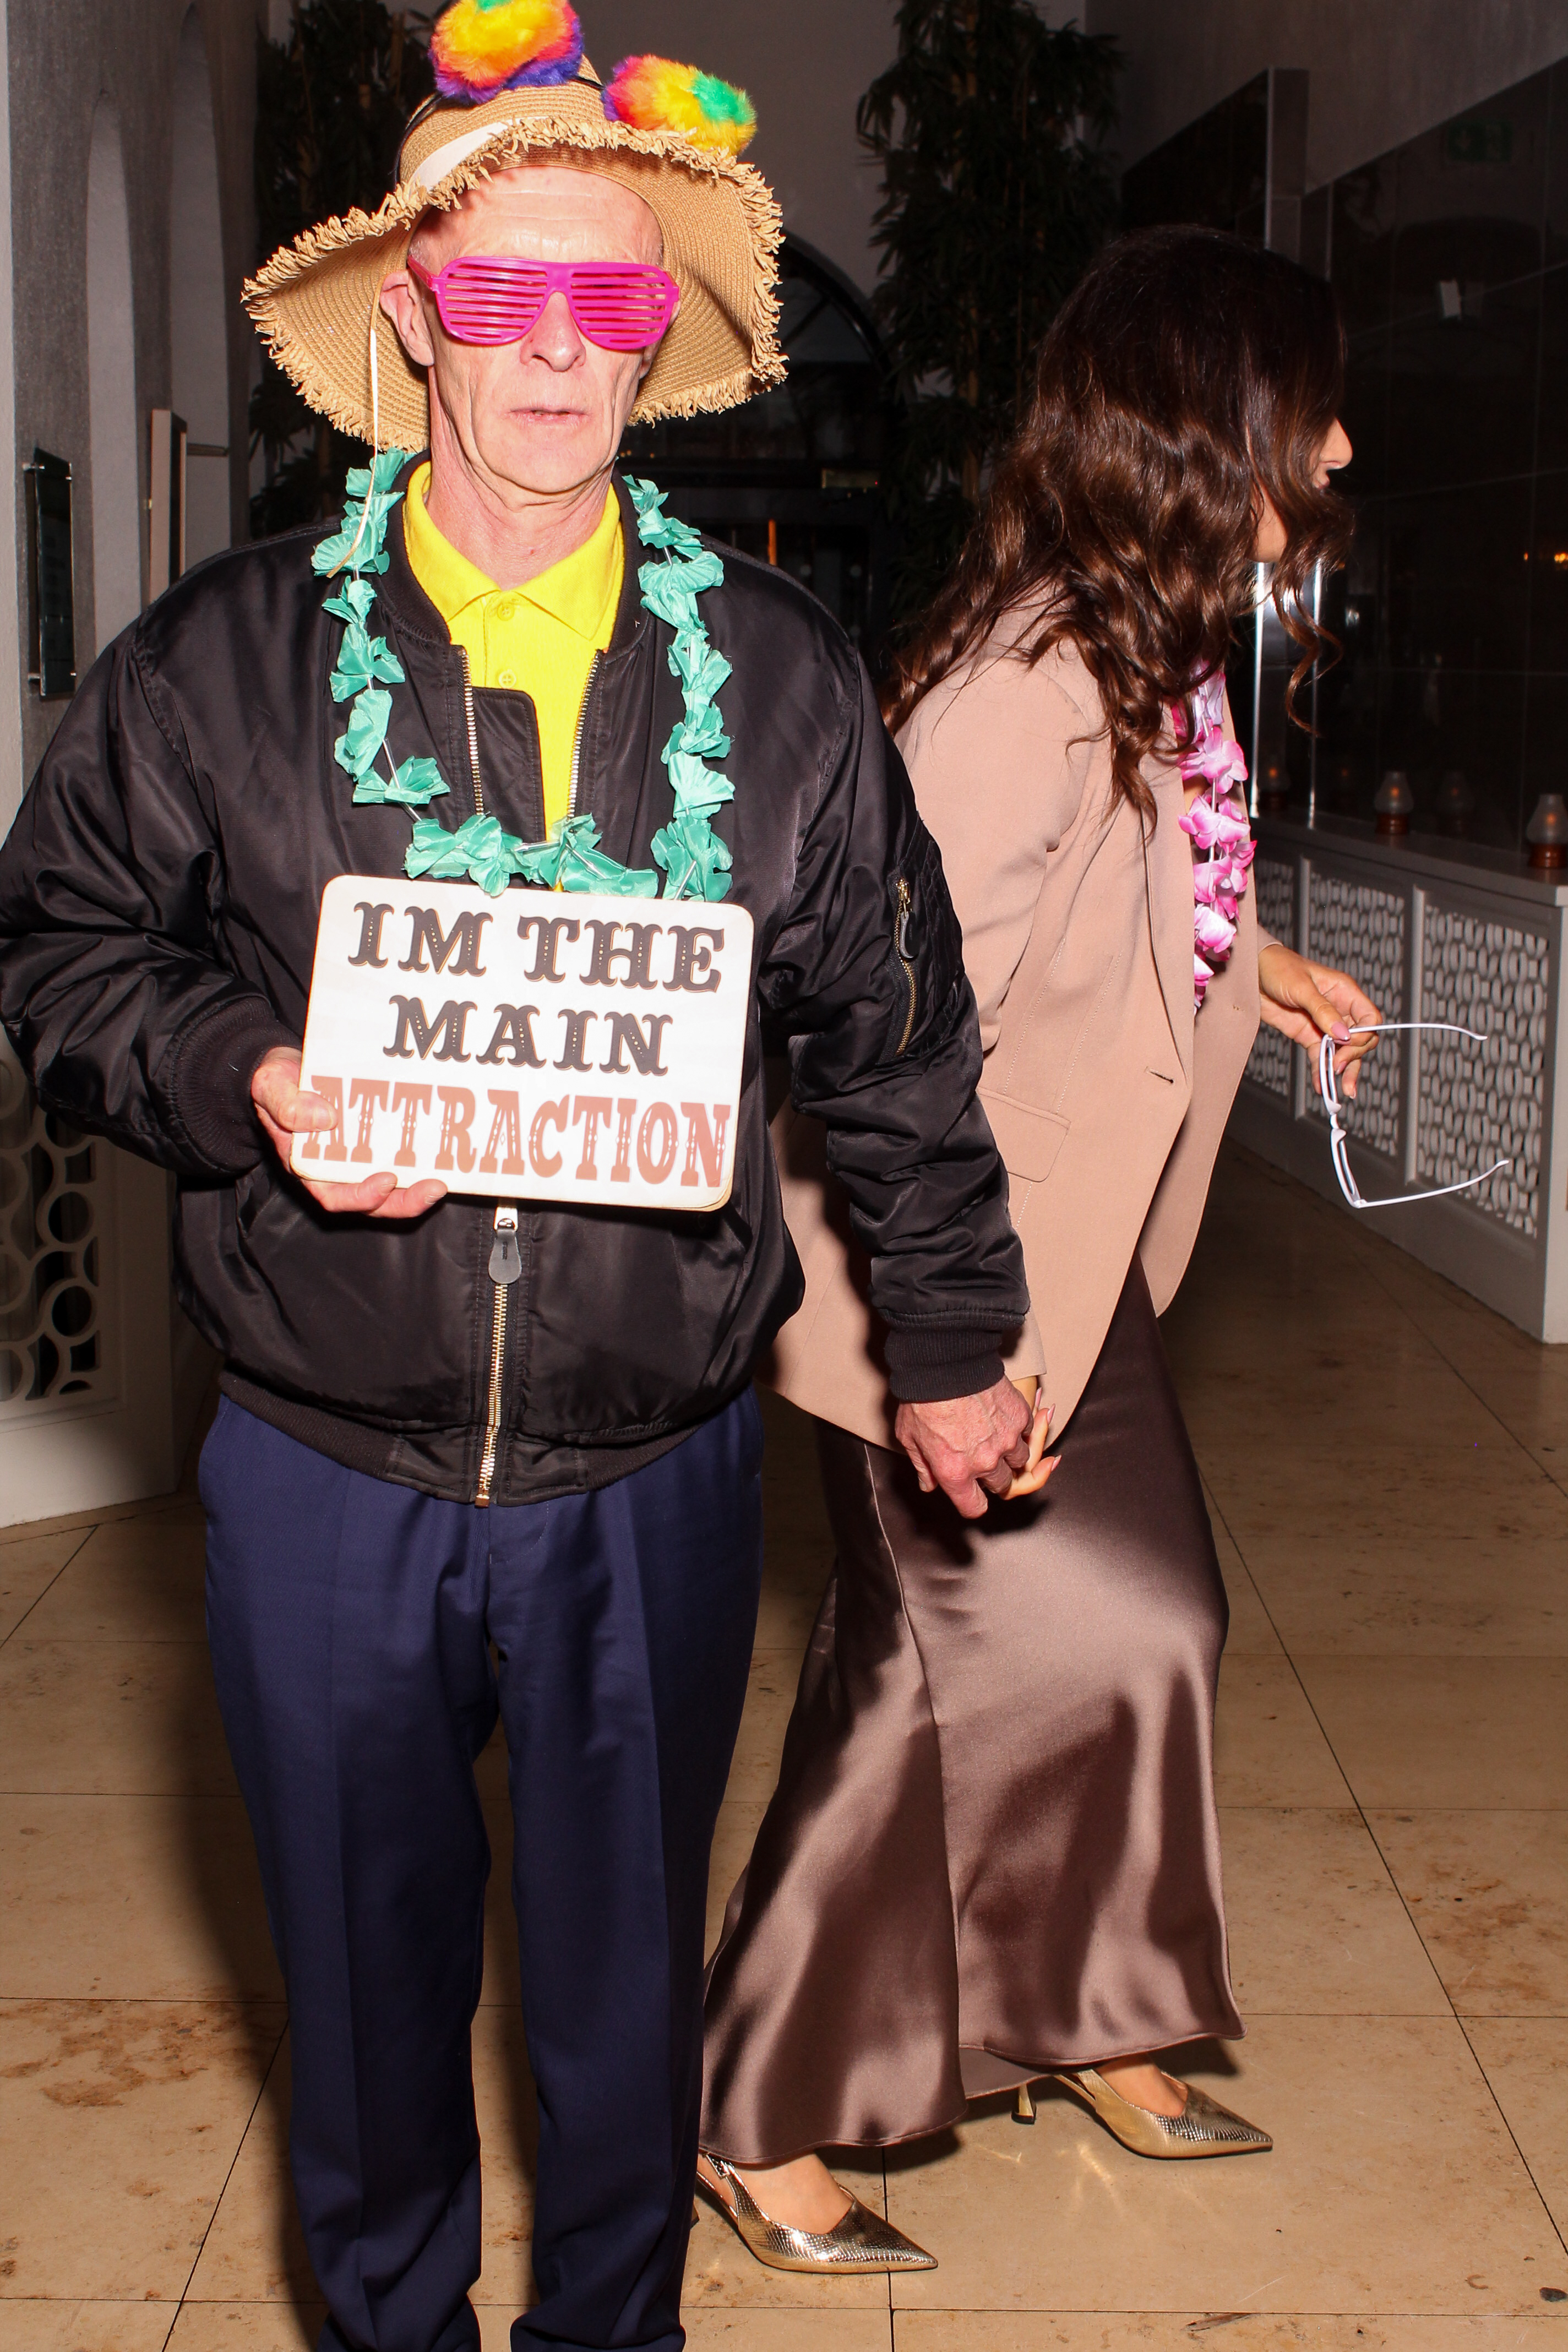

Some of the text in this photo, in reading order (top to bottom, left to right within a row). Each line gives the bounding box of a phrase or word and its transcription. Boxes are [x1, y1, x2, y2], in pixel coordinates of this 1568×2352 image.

[347, 901, 725, 993] IM THE
[383, 995, 673, 1076] MAIN
[301, 1075, 732, 1188] ATTRACTION
